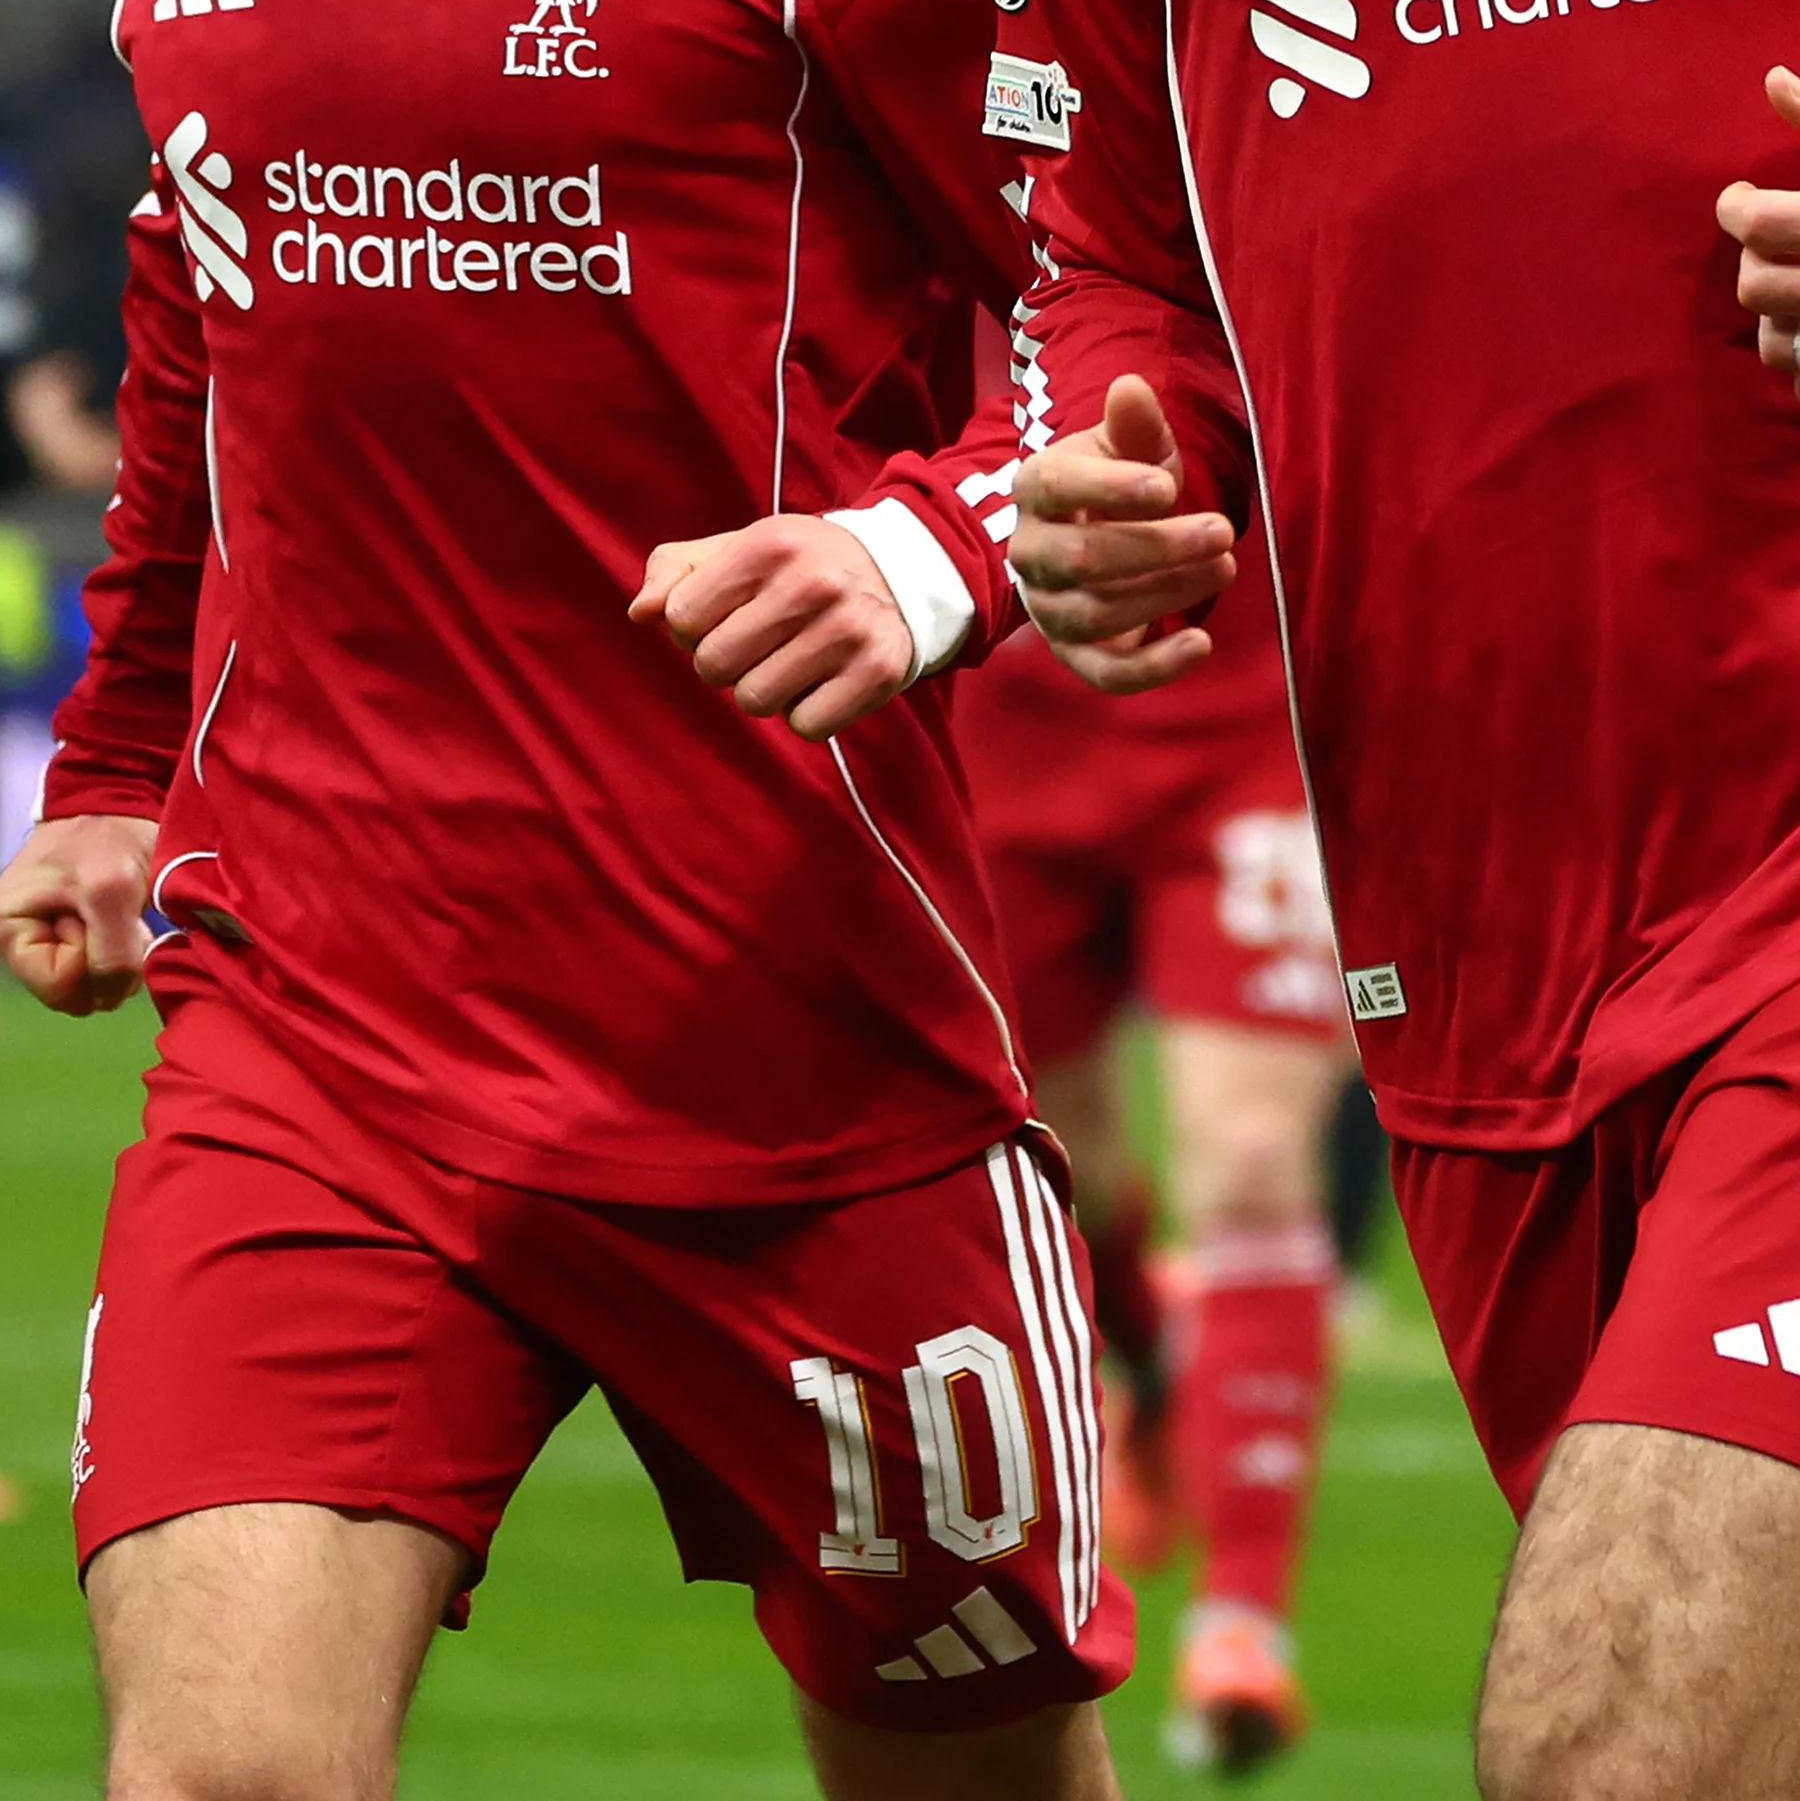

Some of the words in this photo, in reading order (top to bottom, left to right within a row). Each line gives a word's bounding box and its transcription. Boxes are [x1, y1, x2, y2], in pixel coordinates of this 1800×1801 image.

[503, 36, 610, 79] L.F.C.
[264, 149, 601, 227] standard
[270, 222, 632, 297] chartered
[789, 1324, 1042, 1578] 10
